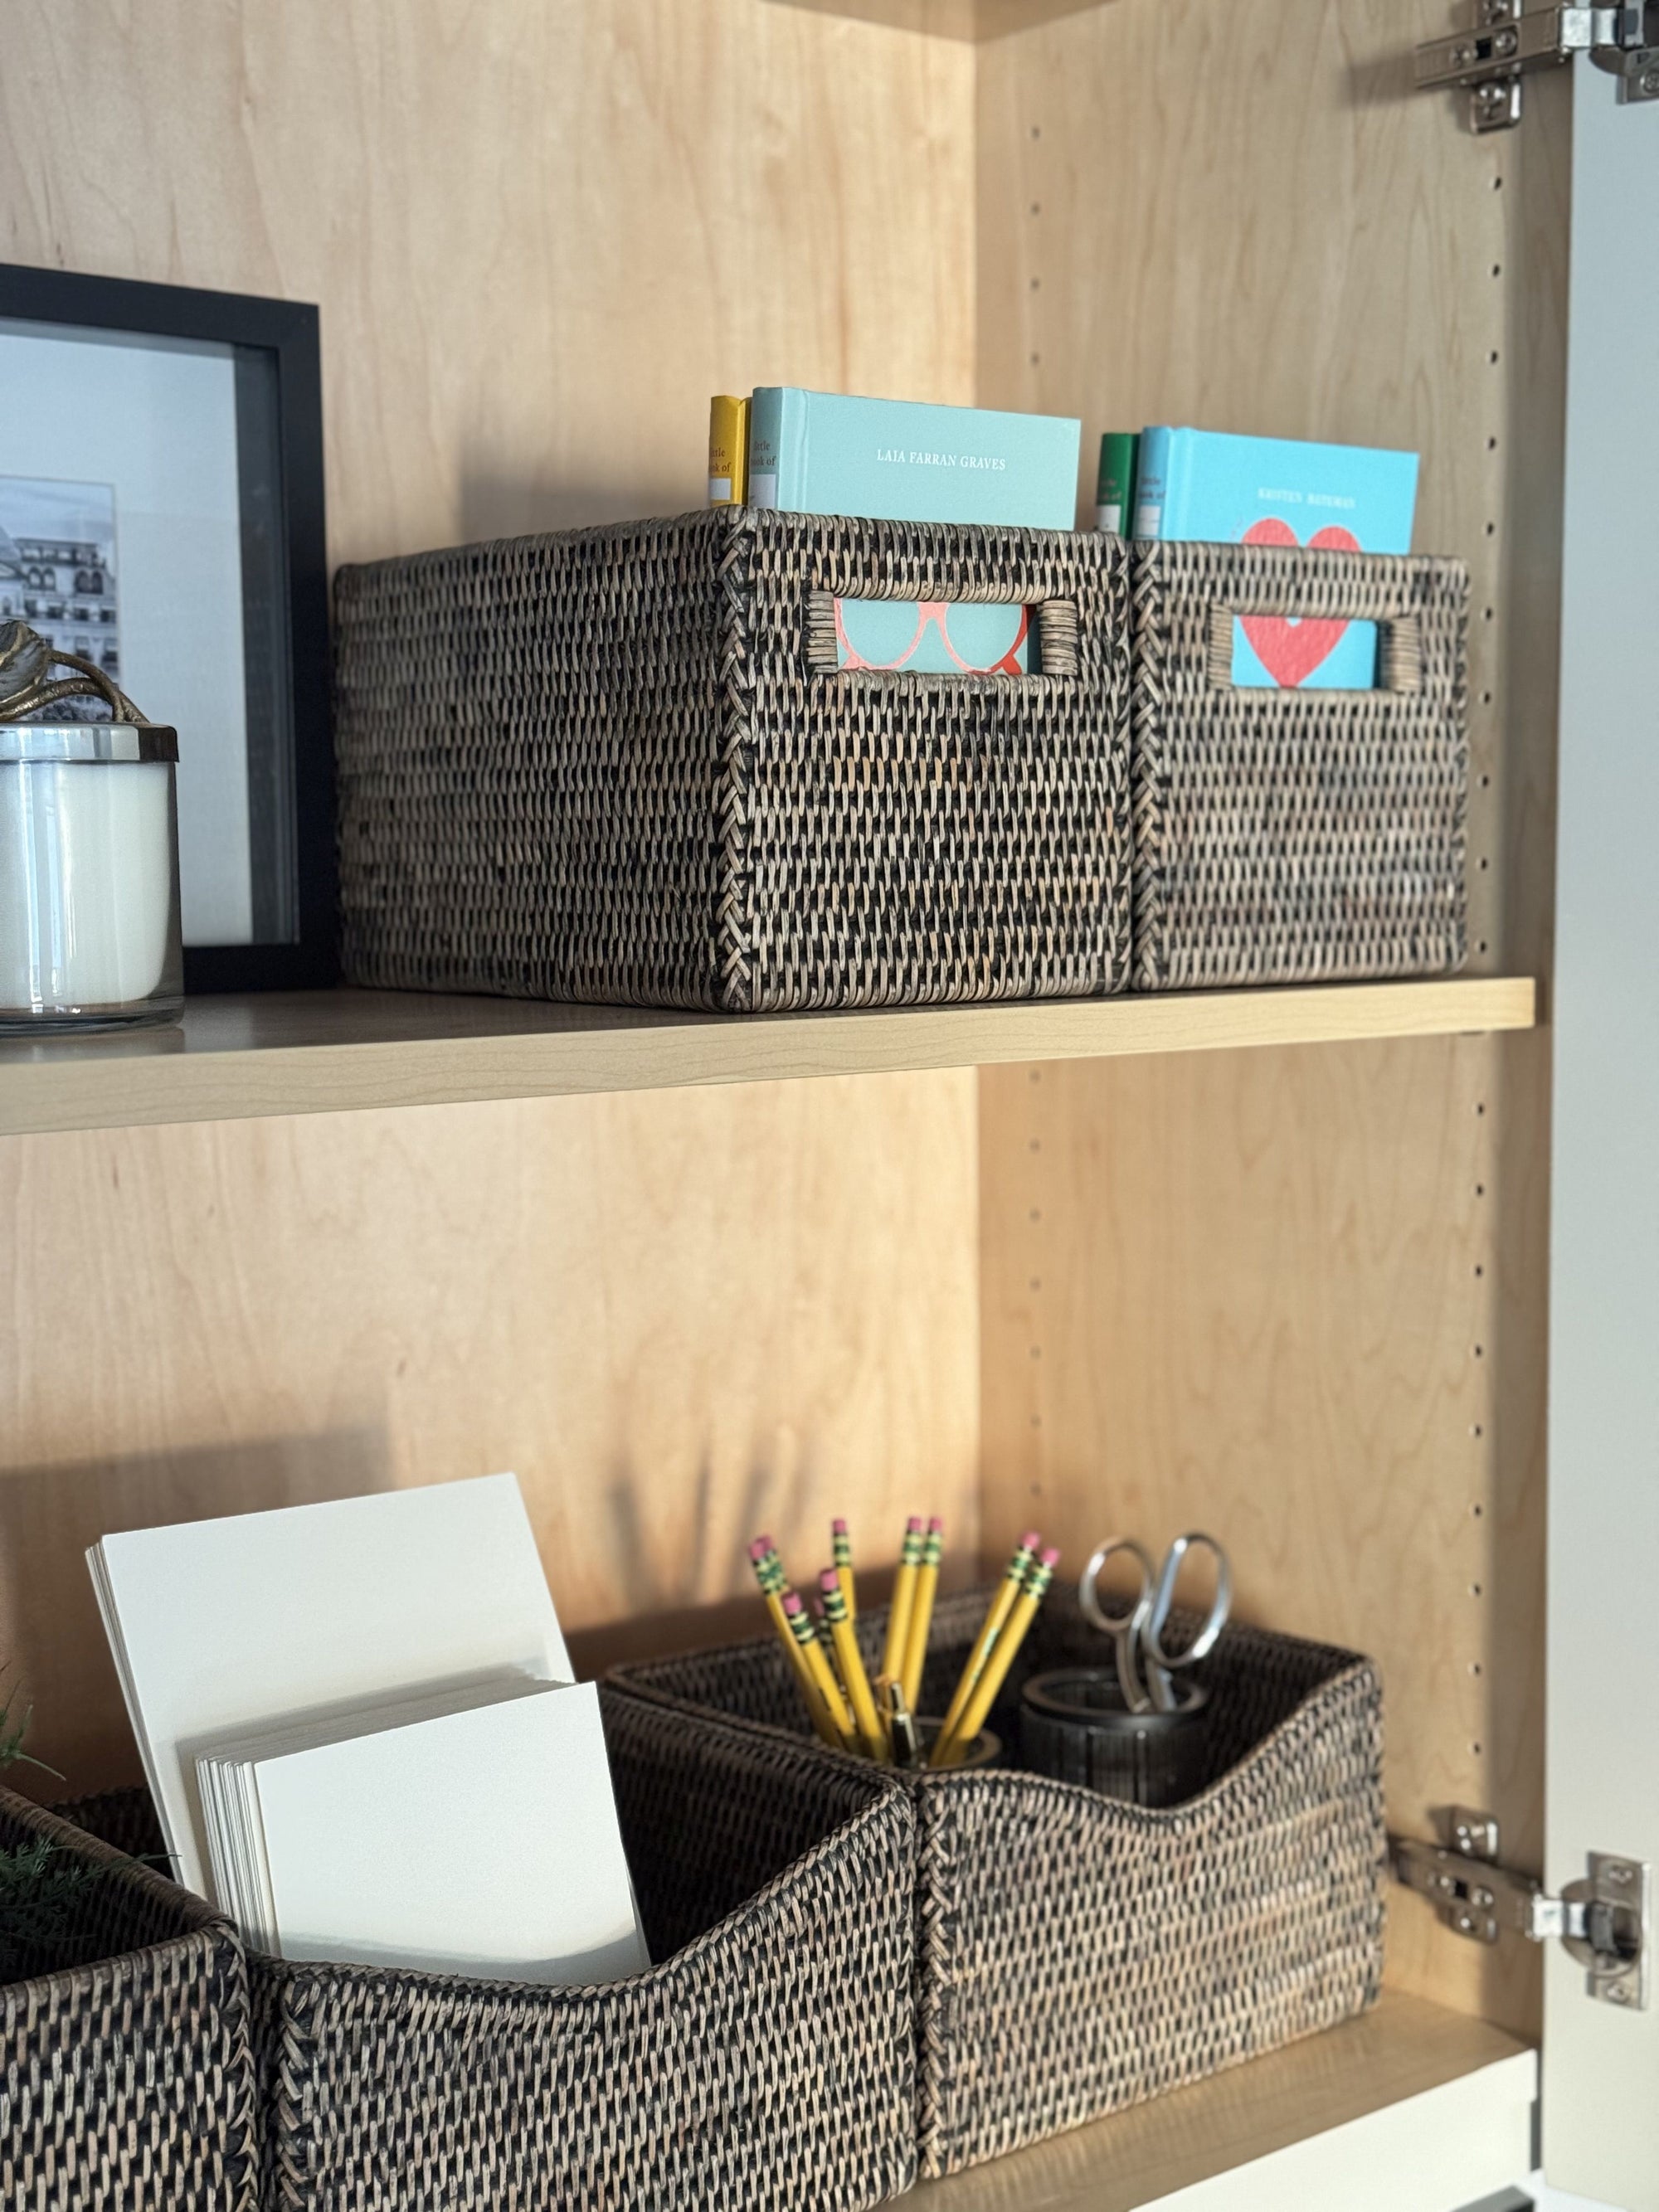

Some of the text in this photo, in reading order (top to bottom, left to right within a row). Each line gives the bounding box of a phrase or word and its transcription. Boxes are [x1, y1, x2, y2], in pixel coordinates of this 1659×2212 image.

[877, 449, 1006, 471] LAIA FARRAN GRAVES
